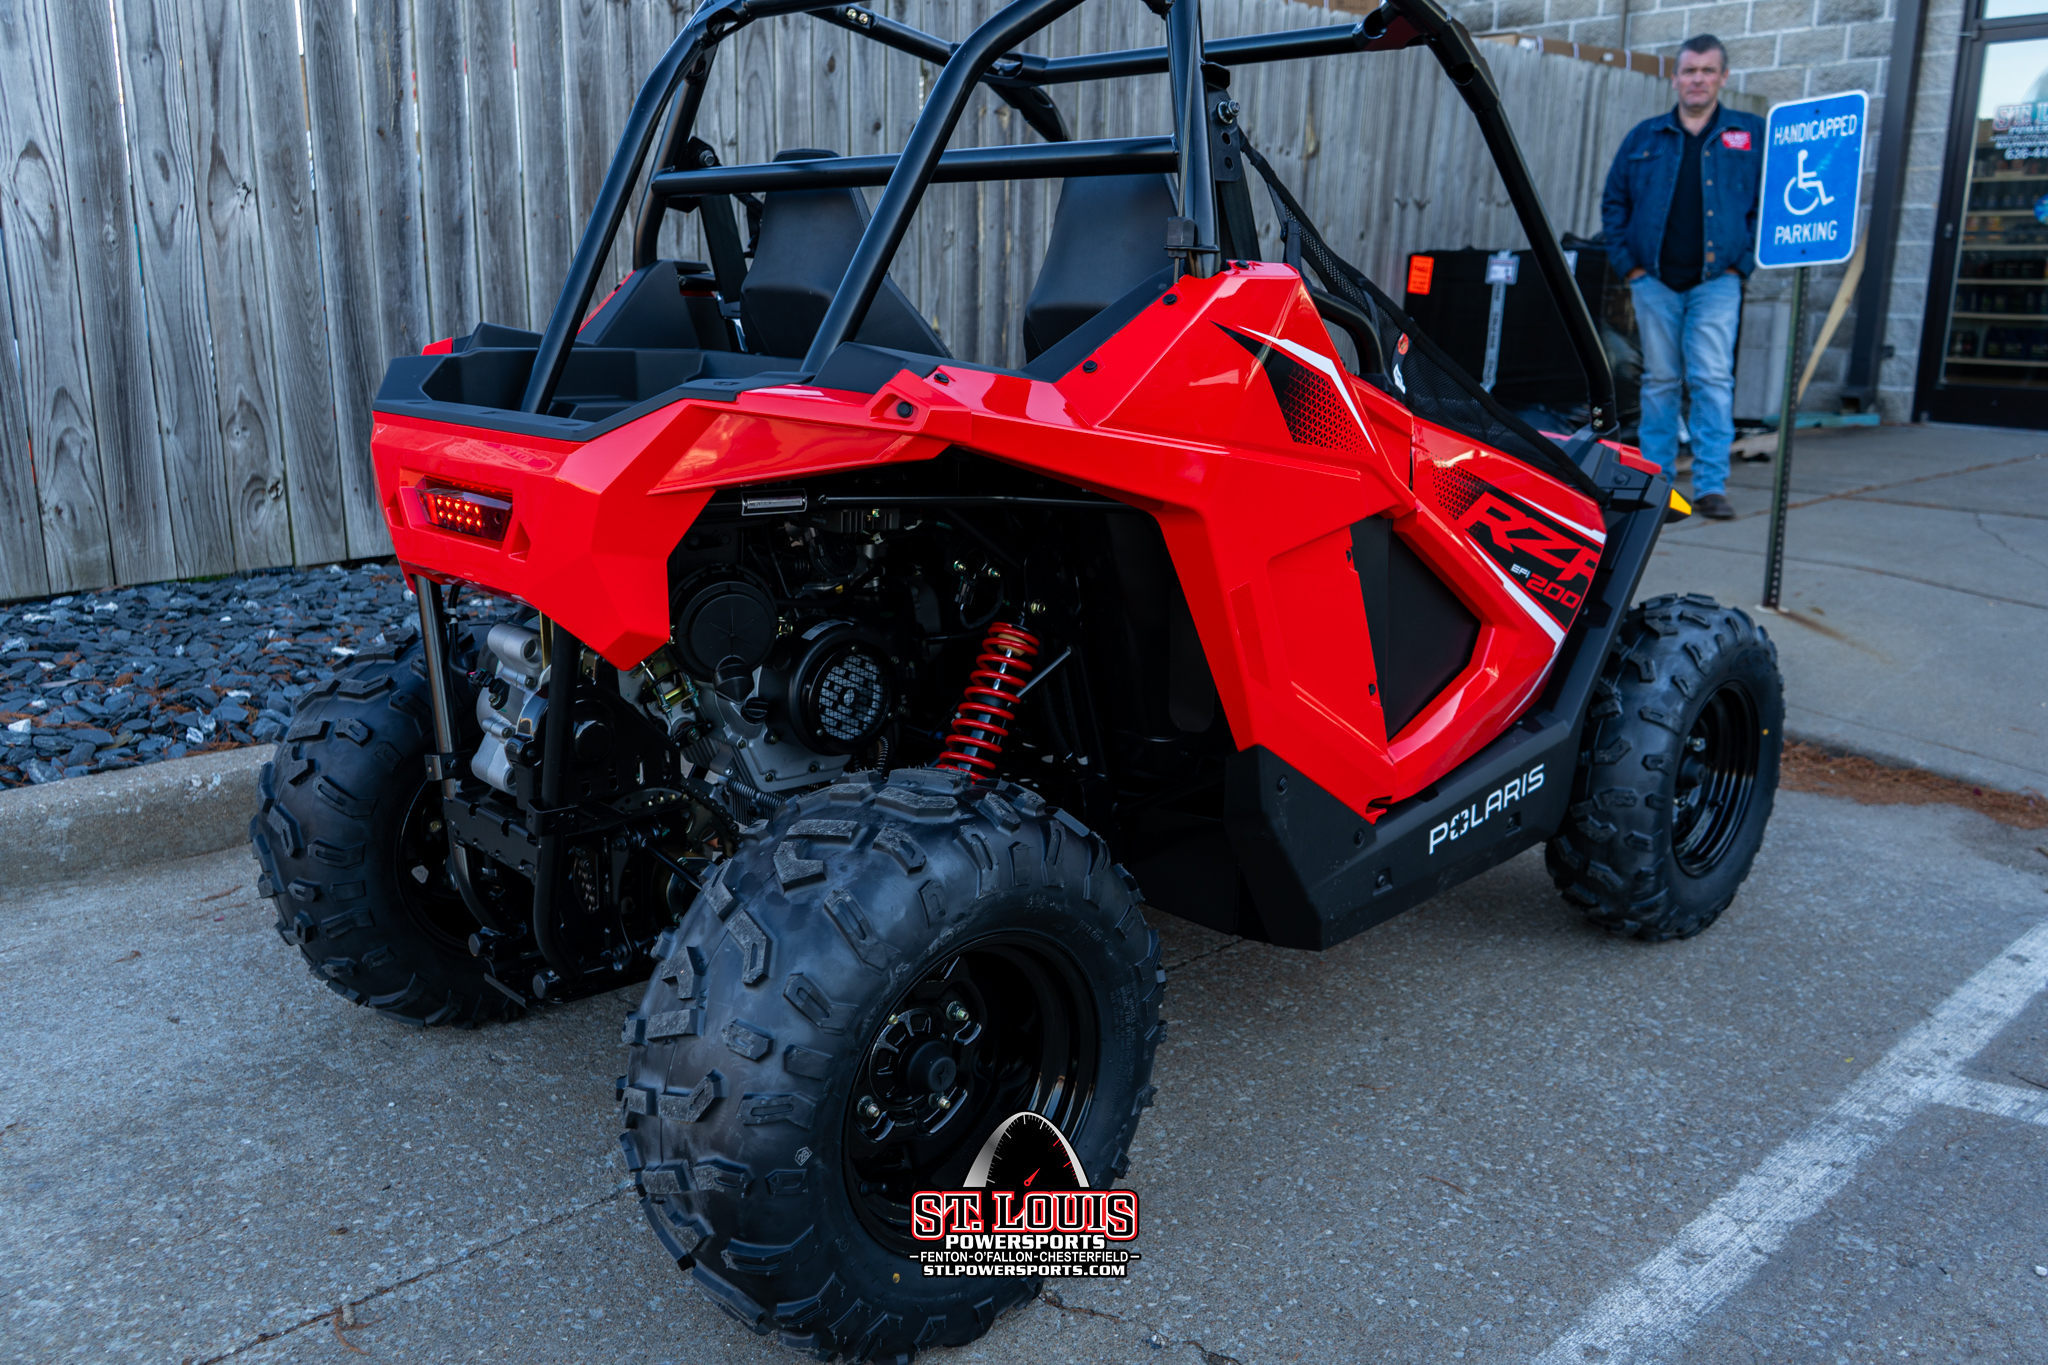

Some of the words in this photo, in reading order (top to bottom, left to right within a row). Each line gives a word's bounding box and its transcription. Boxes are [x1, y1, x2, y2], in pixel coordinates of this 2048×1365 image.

[1774, 114, 1857, 145] HANDICAPPED
[1774, 220, 1838, 246] PARKING
[1510, 563, 1531, 578] EFI
[1525, 573, 1581, 609] 200
[1428, 763, 1546, 855] POLARIS
[797, 1149, 810, 1163] 28
